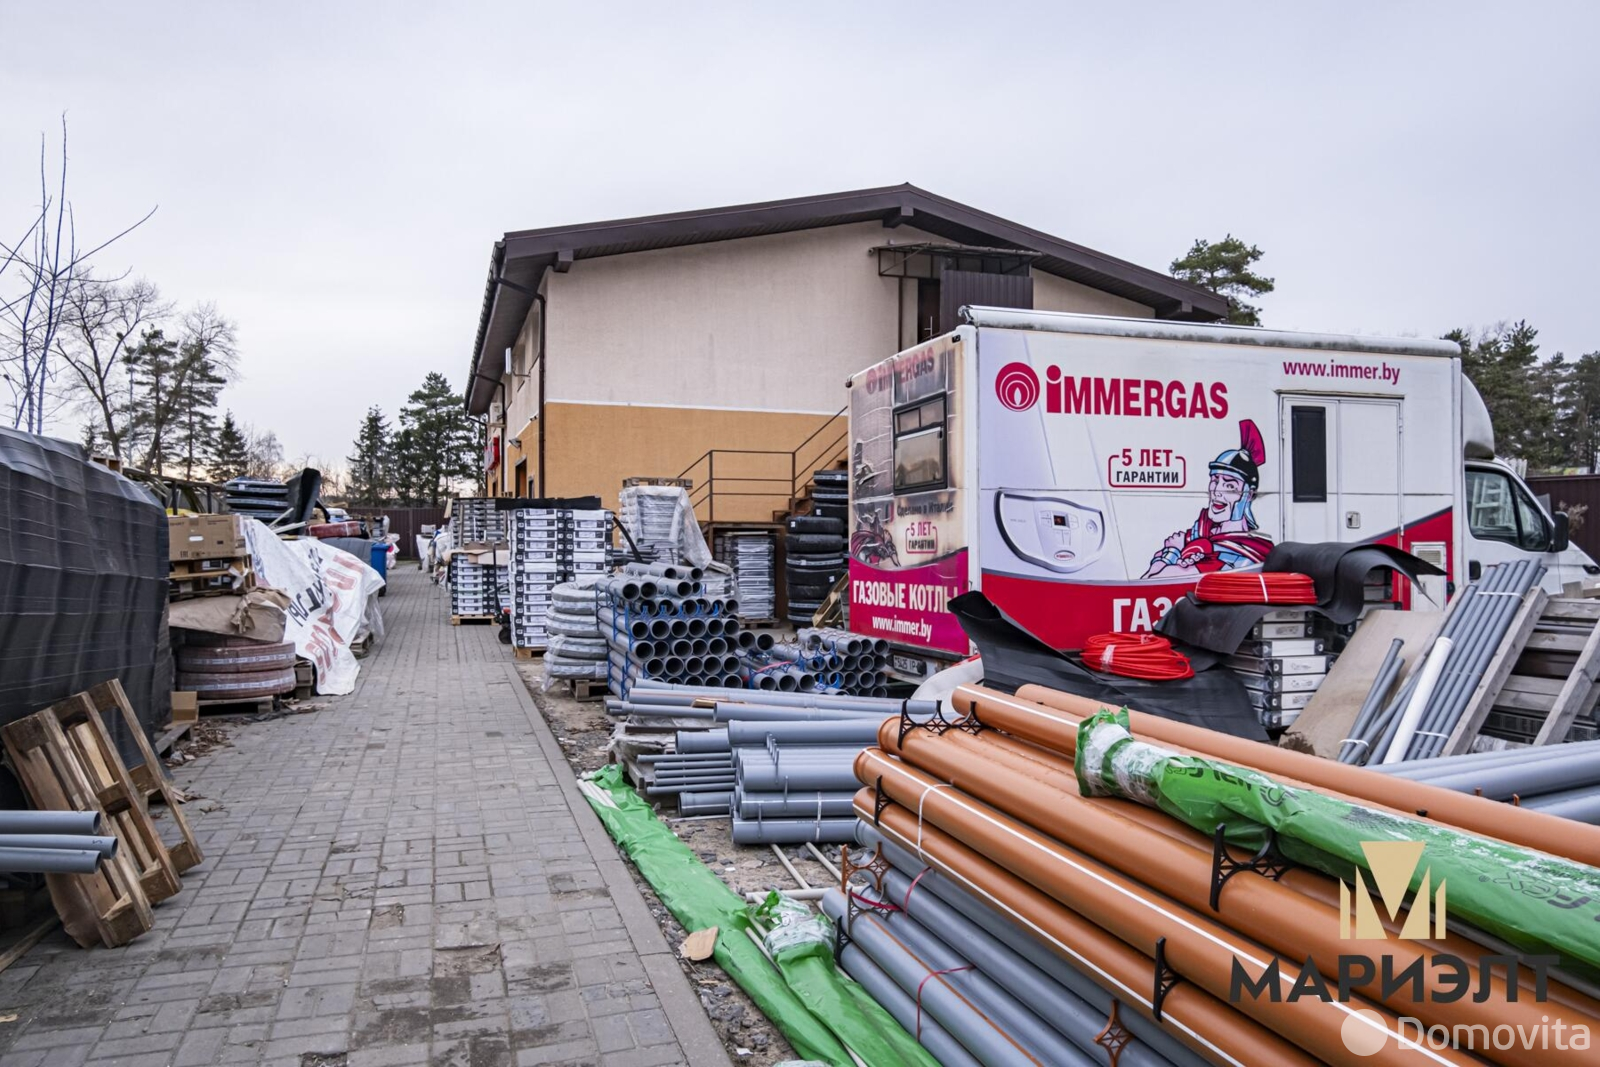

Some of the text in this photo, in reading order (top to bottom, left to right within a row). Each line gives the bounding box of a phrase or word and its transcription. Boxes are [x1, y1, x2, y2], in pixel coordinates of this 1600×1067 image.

[1283, 359, 1401, 385] www.immer.by
[1121, 448, 1173, 468] 5 ЛЕТ
[1115, 470, 1180, 485] ГАРАНТИИ
[910, 522, 931, 536] 5 ЛЕТ
[908, 539, 934, 550] ГАРАНТИИ
[853, 580, 906, 609] ГАЗОВЫЕ
[1112, 596, 1183, 633] ГАЗ
[872, 614, 932, 642] www.immer.by
